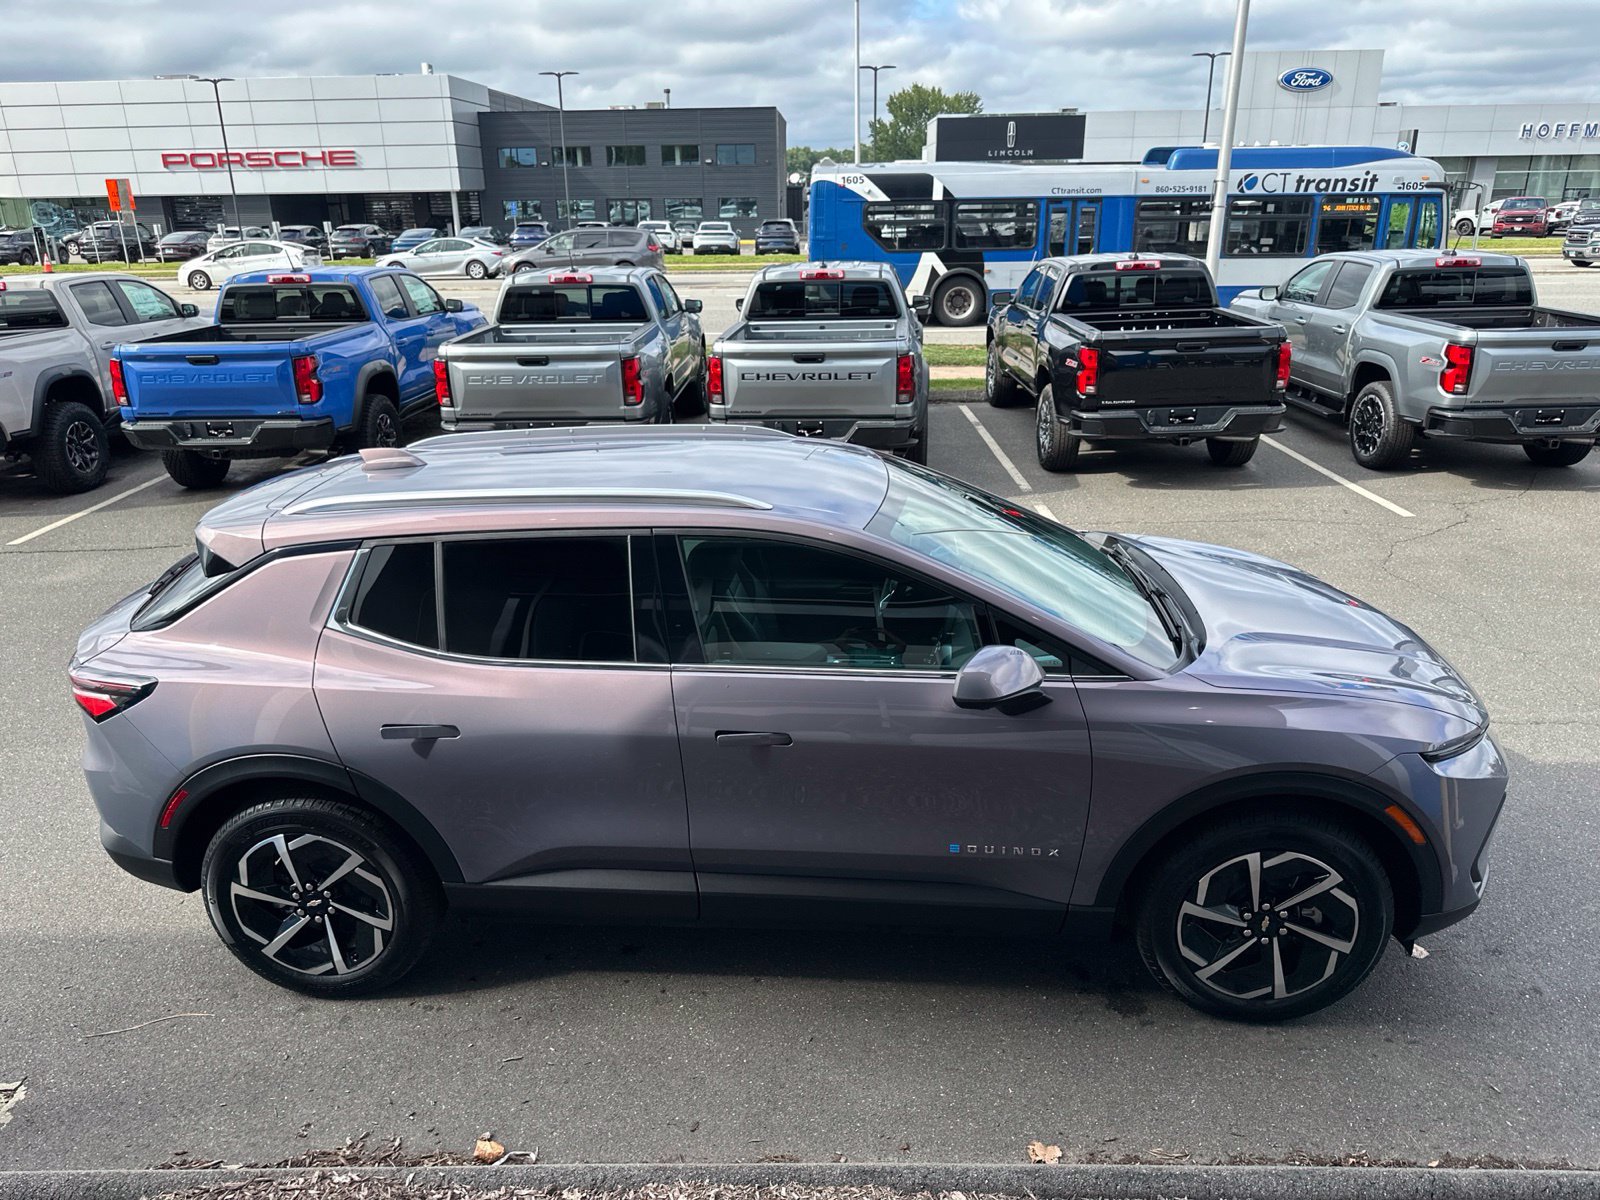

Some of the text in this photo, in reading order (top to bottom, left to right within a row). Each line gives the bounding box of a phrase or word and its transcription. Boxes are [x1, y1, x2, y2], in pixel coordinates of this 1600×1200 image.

[1290, 71, 1324, 86] Ford
[987, 149, 1034, 157] LINCOLN
[162, 150, 357, 170] PORSCHE
[841, 176, 865, 184] 1605
[1261, 170, 1380, 193] CT transit
[1051, 187, 1102, 195] CTtransit.com
[1401, 182, 1425, 190] 1605
[141, 373, 274, 384] CHEVROLET
[467, 374, 604, 385] CHEVROLET
[741, 371, 878, 382] CHEVROLET
[949, 844, 1060, 857] EQUINOX
